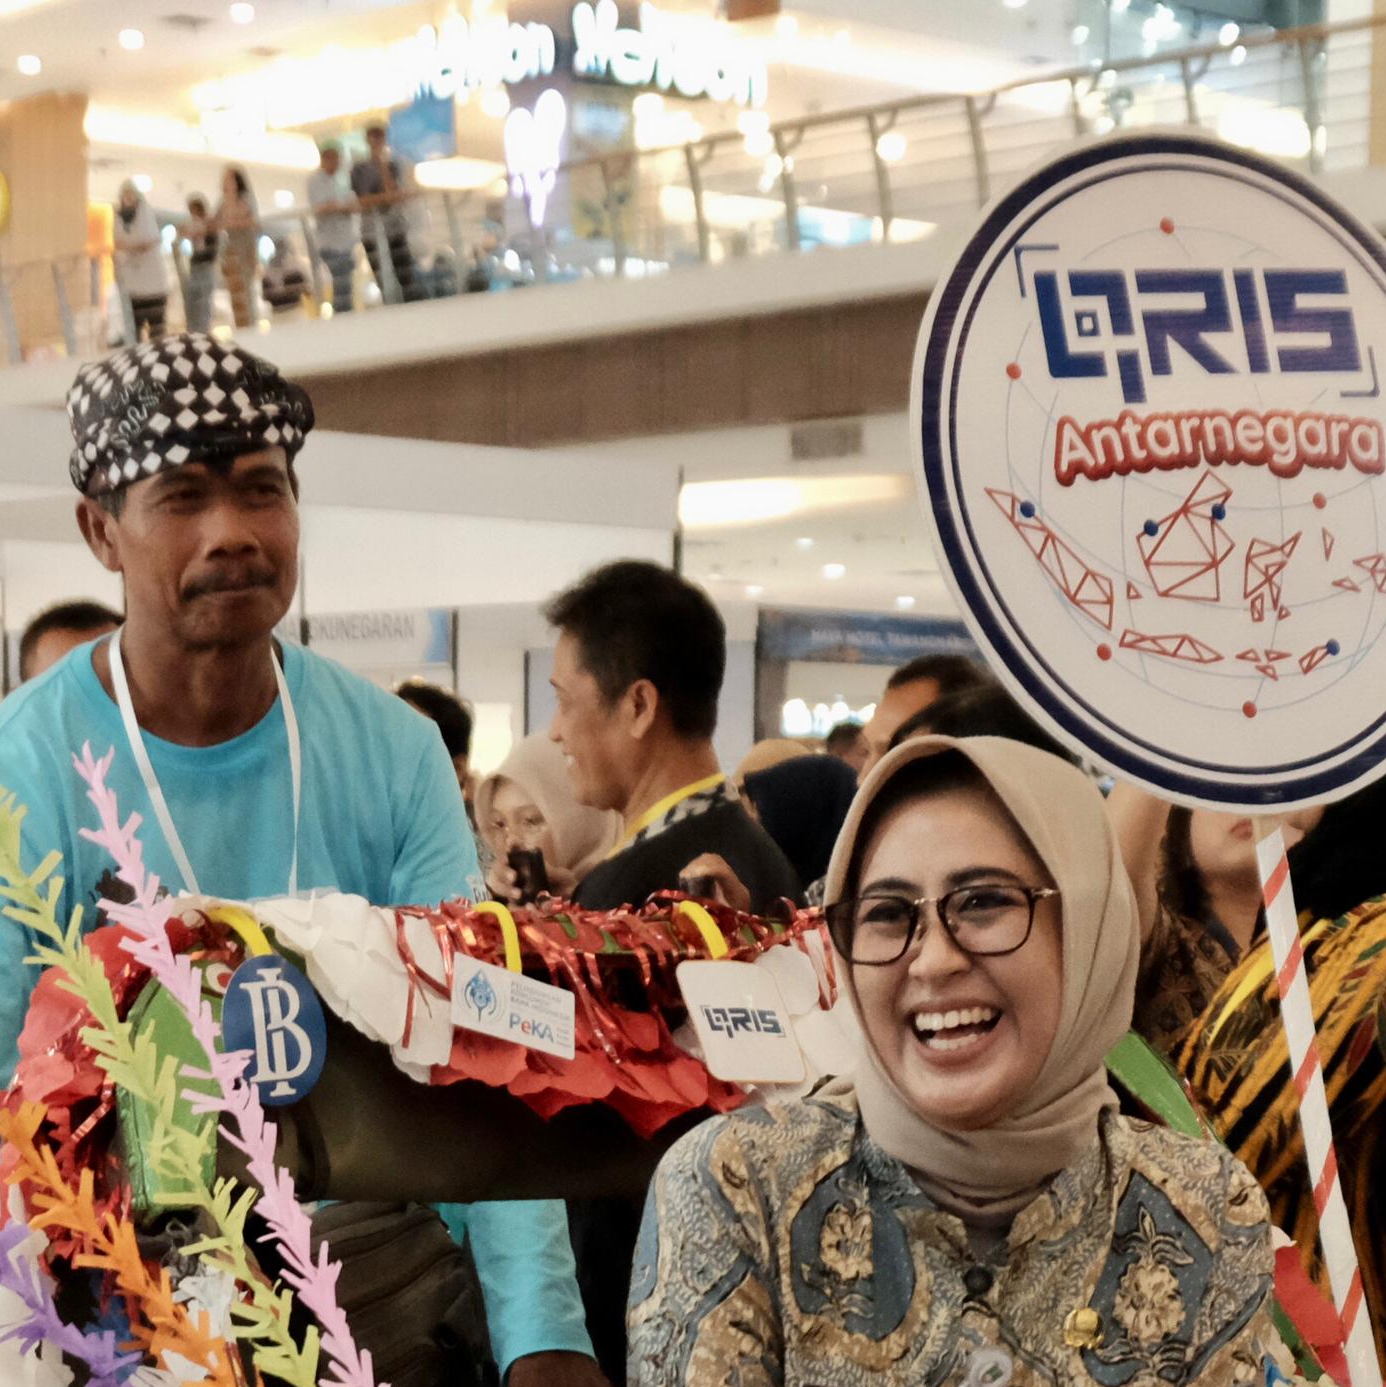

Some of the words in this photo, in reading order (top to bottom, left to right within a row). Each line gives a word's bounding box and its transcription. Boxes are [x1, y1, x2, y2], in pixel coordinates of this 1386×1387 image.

[1033, 268, 1361, 404] QRIS
[1056, 410, 1384, 486] Antarnegara
[509, 1012, 555, 1044] PeKA
[704, 1007, 782, 1039] QRIS
